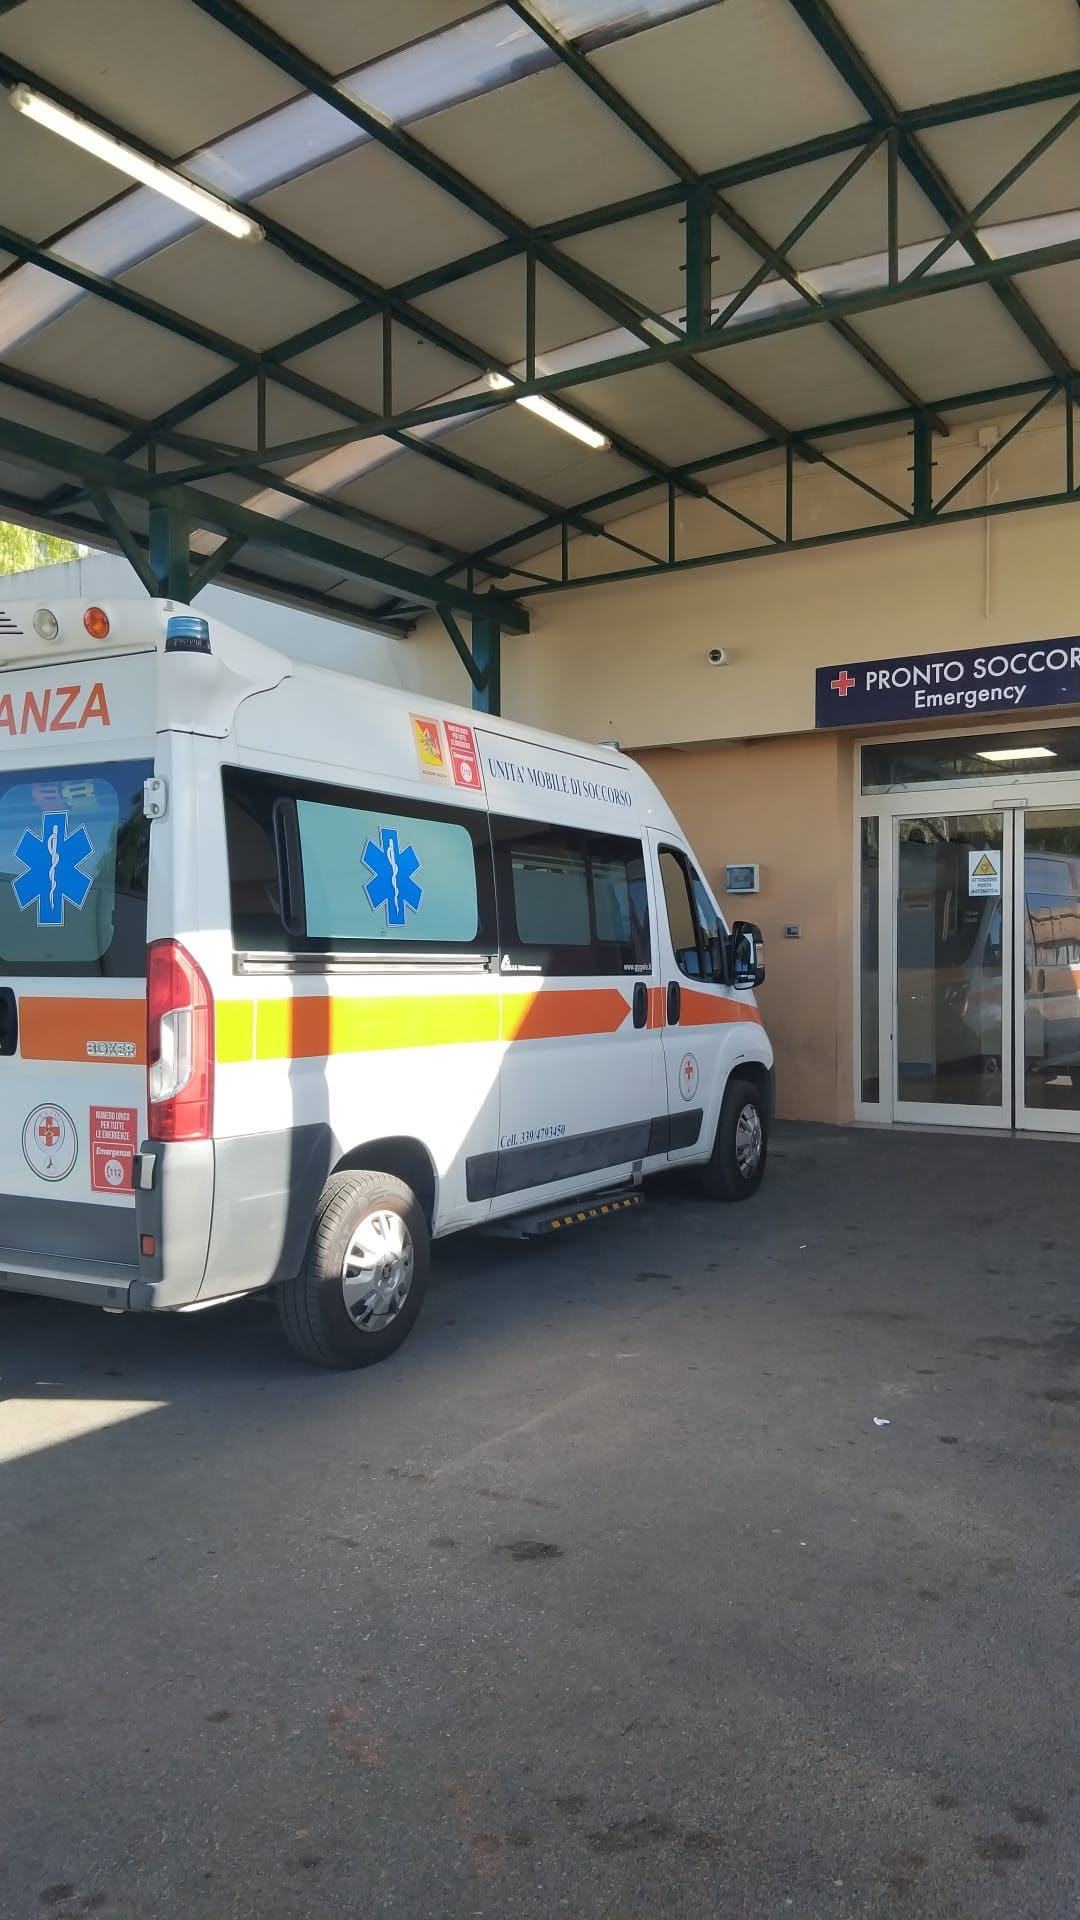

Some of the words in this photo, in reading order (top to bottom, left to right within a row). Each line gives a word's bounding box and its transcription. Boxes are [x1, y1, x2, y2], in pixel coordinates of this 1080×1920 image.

[866, 661, 964, 691] PRONTO
[914, 685, 1027, 709] Emergency
[527, 767, 570, 794] MOBILE
[570, 777, 582, 797] DI
[582, 780, 633, 807] SOCCORSO
[100, 1120, 110, 1129] PER
[110, 1121, 125, 1130] TUTTE
[109, 1168, 122, 1177] 112
